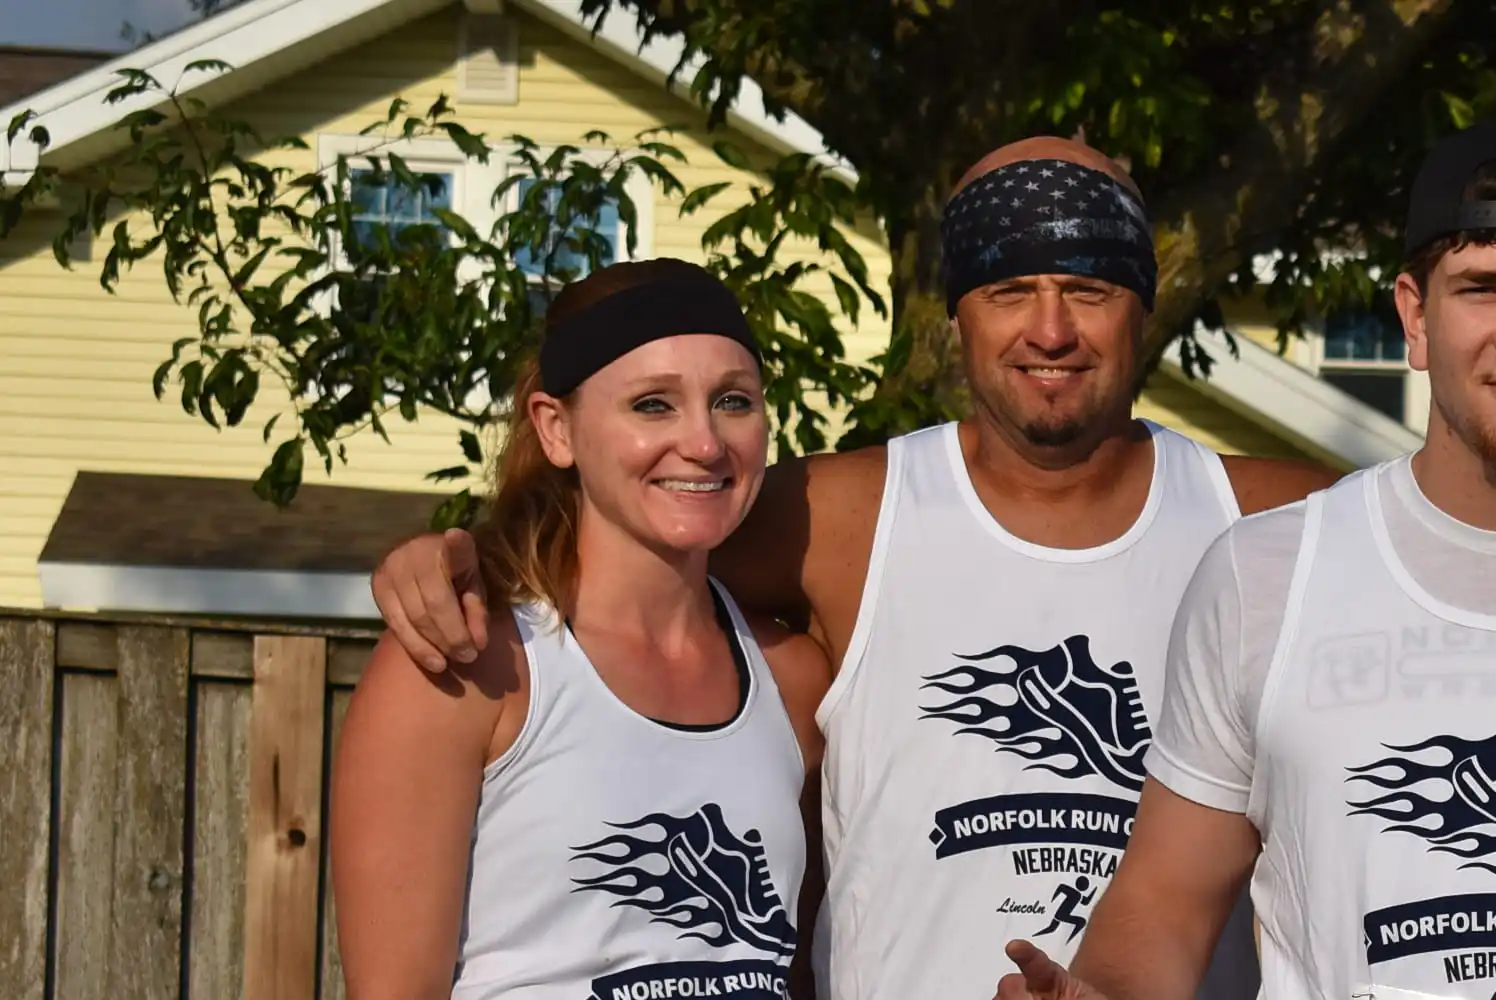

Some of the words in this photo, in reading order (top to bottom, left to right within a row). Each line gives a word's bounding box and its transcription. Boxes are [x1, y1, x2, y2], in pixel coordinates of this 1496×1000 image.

[953, 809, 1066, 839] NORFOLK
[1072, 810, 1118, 835] RUN
[1013, 848, 1118, 878] NEBRASKA
[996, 898, 1045, 915] Lincoln
[724, 972, 772, 993] RUN
